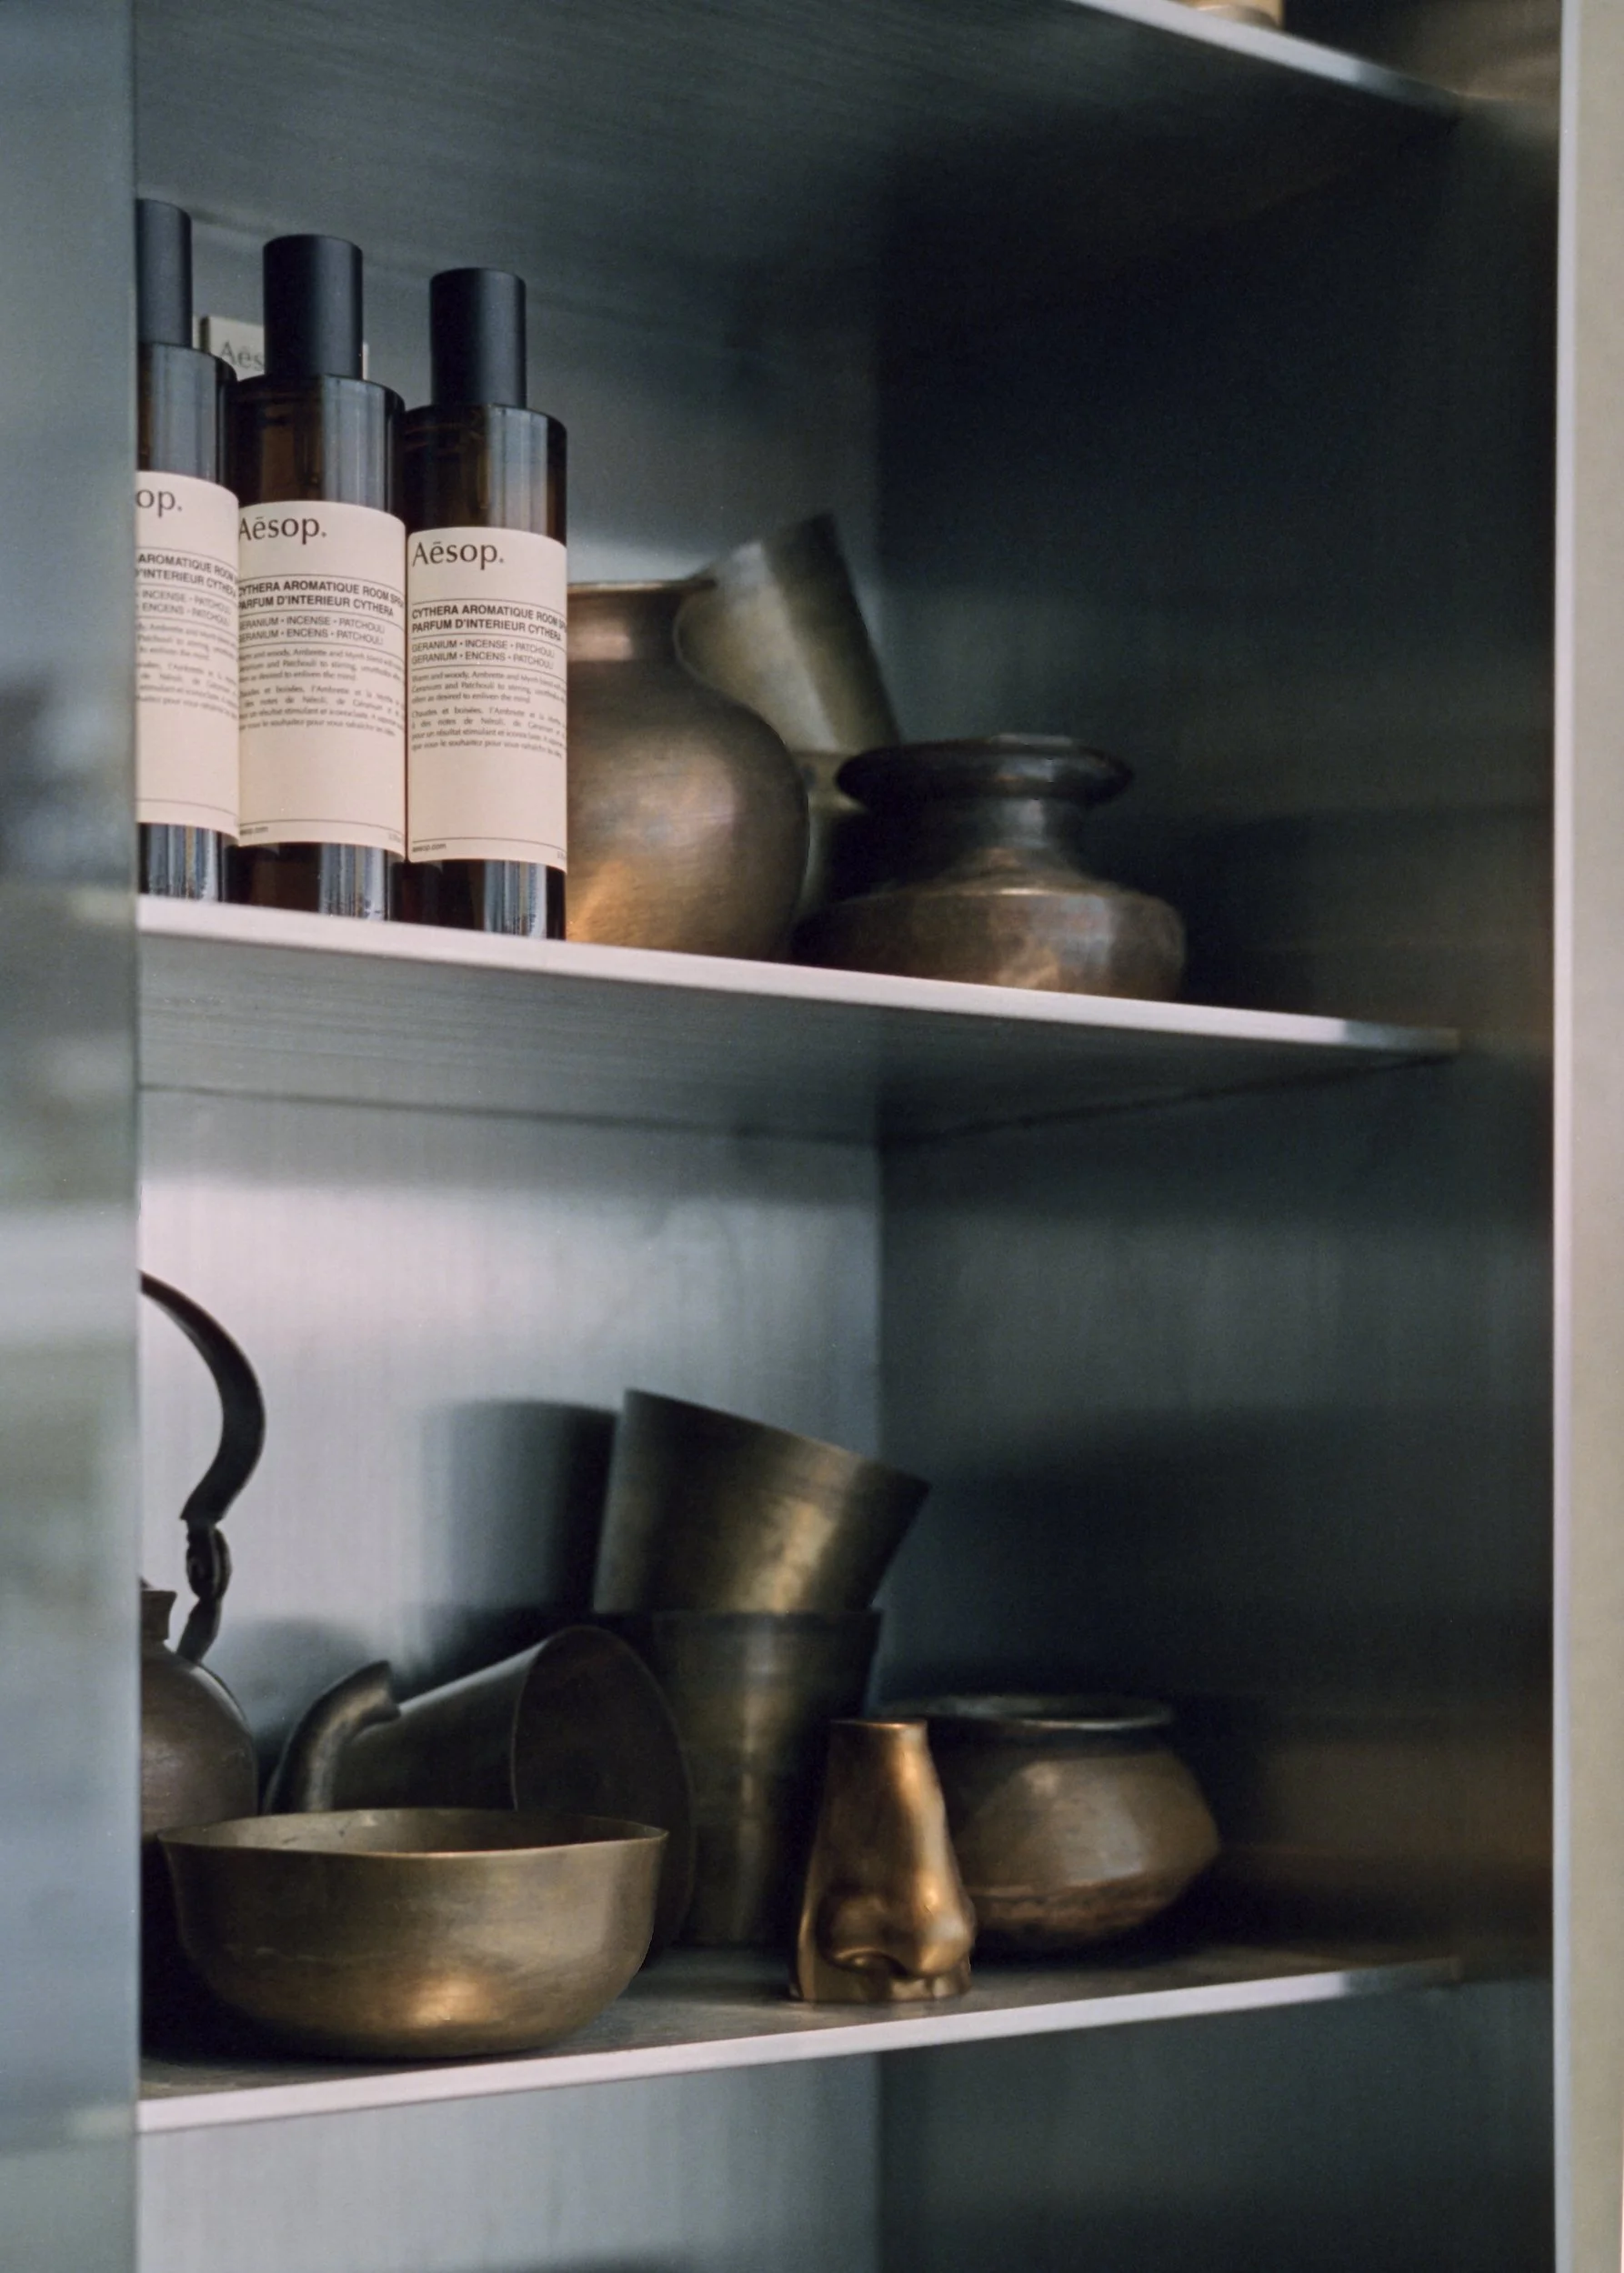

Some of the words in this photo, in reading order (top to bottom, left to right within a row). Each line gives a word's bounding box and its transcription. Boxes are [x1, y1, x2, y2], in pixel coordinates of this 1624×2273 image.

[239, 516, 327, 546] Aēsop.
[138, 553, 211, 573] AROMATIQUE
[412, 541, 505, 571] Aēsop.
[284, 580, 360, 595] AROMATIQUE
[363, 586, 389, 601] ROOM
[276, 595, 351, 608] D'INTERIEUR
[354, 598, 394, 616] CYTHERA
[412, 605, 459, 619] CYTHERA
[462, 605, 534, 619] AROMATIQUE
[536, 611, 557, 626] ROOM
[286, 616, 330, 626] INCENSE
[339, 618, 385, 635] PATCHOULI
[412, 619, 452, 633] PARFUM
[456, 618, 526, 632] D'INTERIEUR
[528, 624, 561, 641] CYTHERA
[286, 628, 328, 638] ENCENS
[336, 629, 383, 646] PATCHOULI
[412, 640, 456, 653] GERANIUM
[465, 639, 507, 648] INCENSE
[516, 642, 554, 658] PATCHOULI
[412, 652, 456, 665] GERANIUM
[465, 651, 506, 661] ENCENS
[514, 653, 553, 670] PATCHOULI
